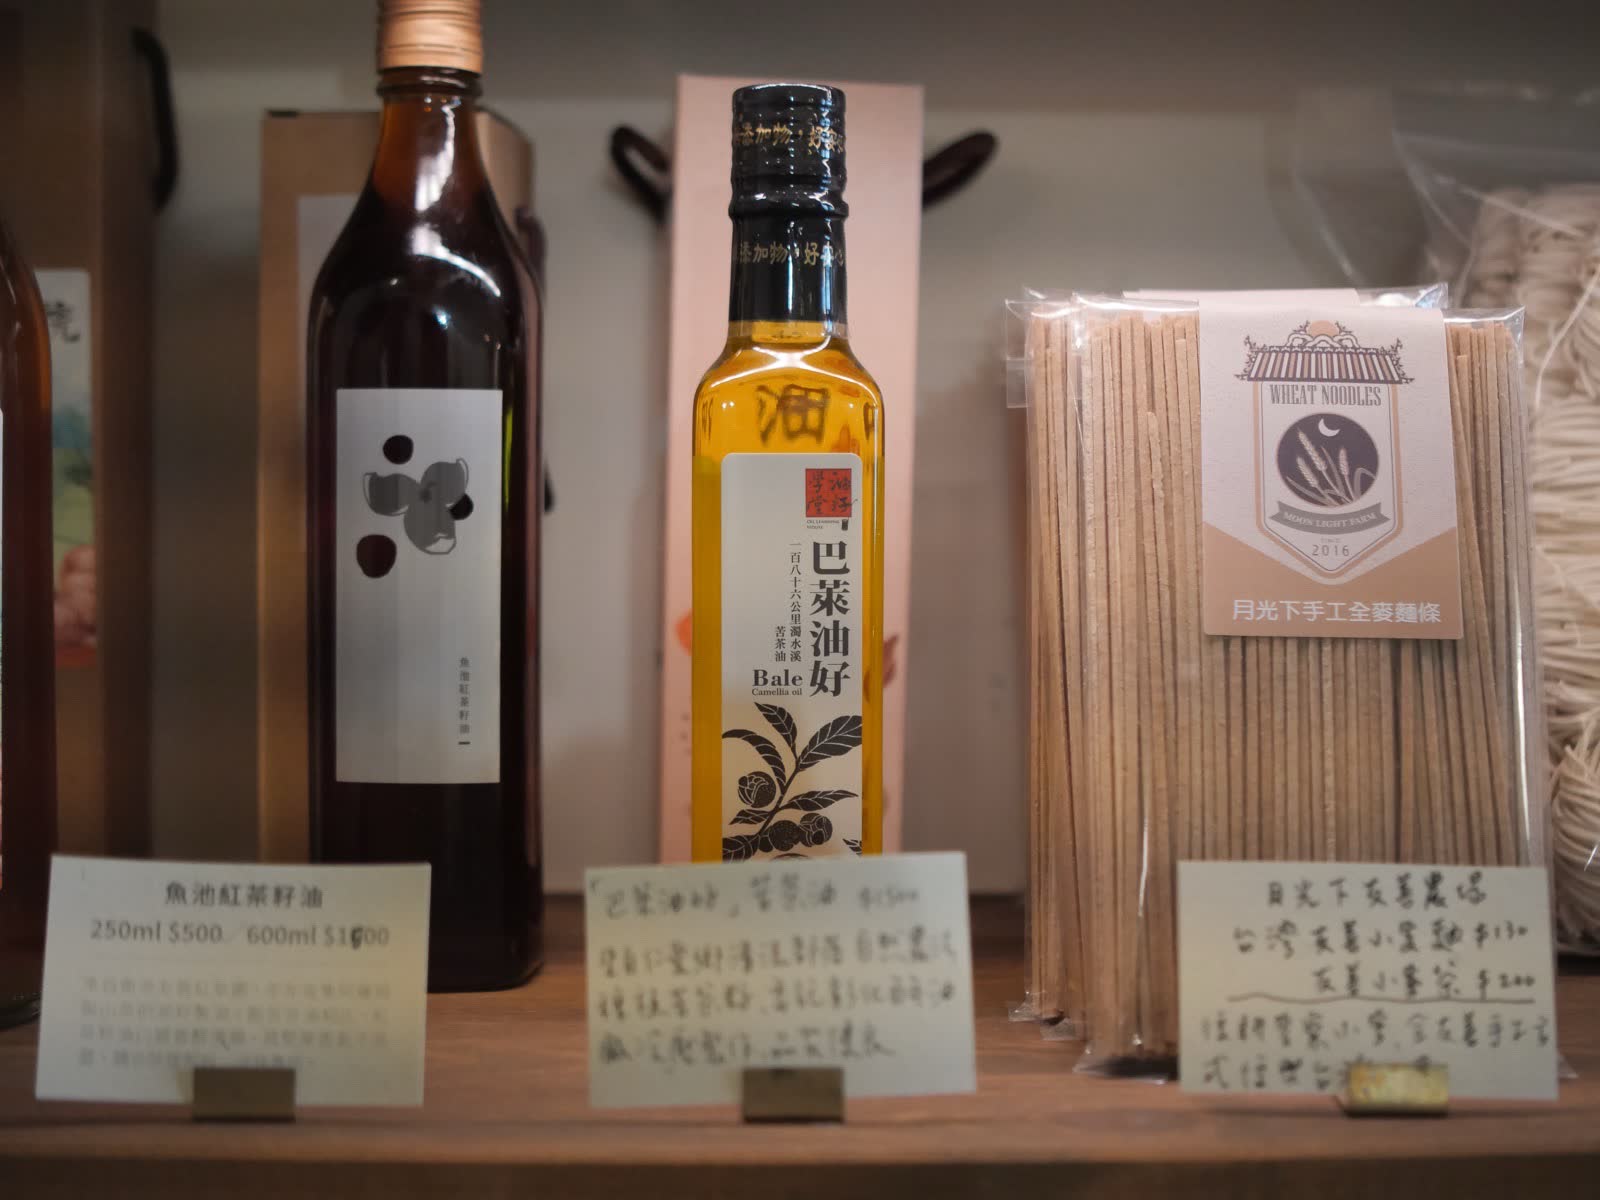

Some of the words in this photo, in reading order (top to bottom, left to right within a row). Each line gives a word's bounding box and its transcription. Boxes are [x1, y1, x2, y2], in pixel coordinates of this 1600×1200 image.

[1269, 384, 1318, 406] WHEAT
[1321, 384, 1382, 407] NOODLES
[1283, 511, 1313, 526] MOON
[1315, 519, 1348, 528] LIGHT
[1350, 511, 1378, 526] FARM
[1312, 544, 1350, 556] 2016
[789, 543, 802, 663] 一百八十六公里濁水溪
[809, 541, 850, 697] 巴萊油好
[774, 626, 787, 662] 苦茶油
[752, 669, 803, 687] Bale
[752, 687, 790, 697] Camellia
[791, 687, 803, 697] oil
[90, 919, 162, 941] 250ml
[167, 921, 224, 944] $500
[247, 924, 318, 947] 600ml
